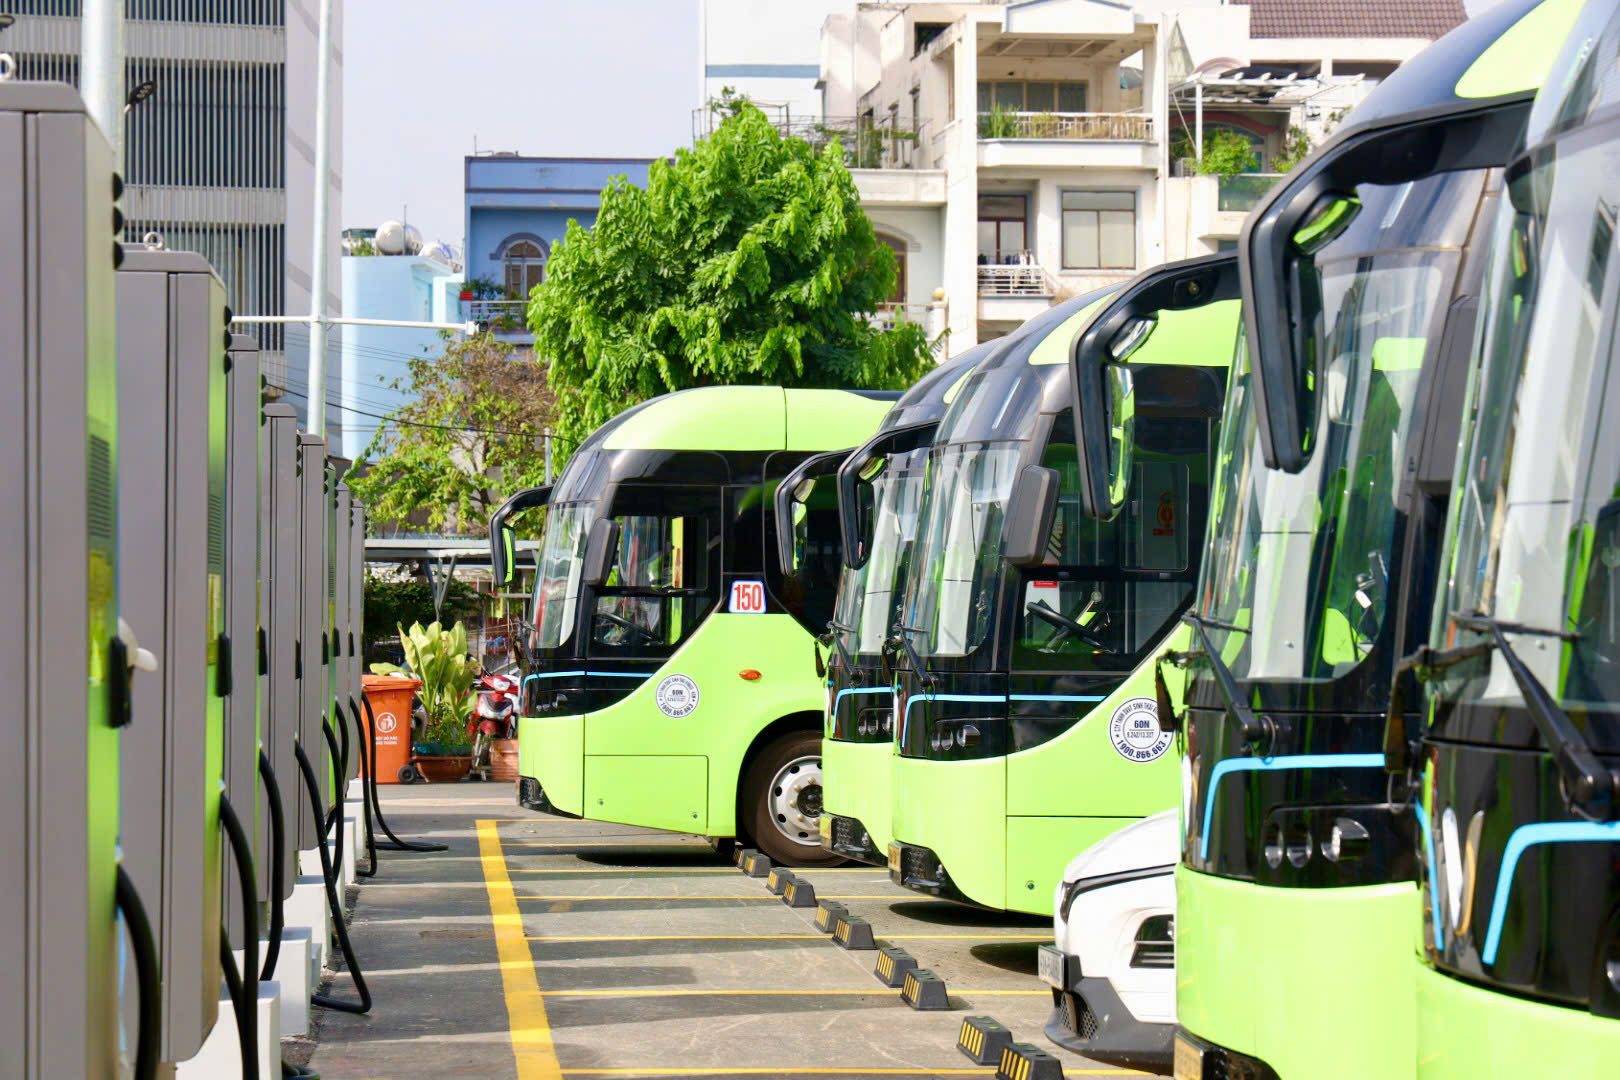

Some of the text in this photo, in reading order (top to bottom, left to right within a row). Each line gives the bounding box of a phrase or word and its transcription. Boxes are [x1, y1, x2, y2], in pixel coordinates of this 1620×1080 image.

[734, 584, 762, 611] 150
[1134, 720, 1150, 728] 60N
[1117, 740, 1166, 758] 1900.866.663
